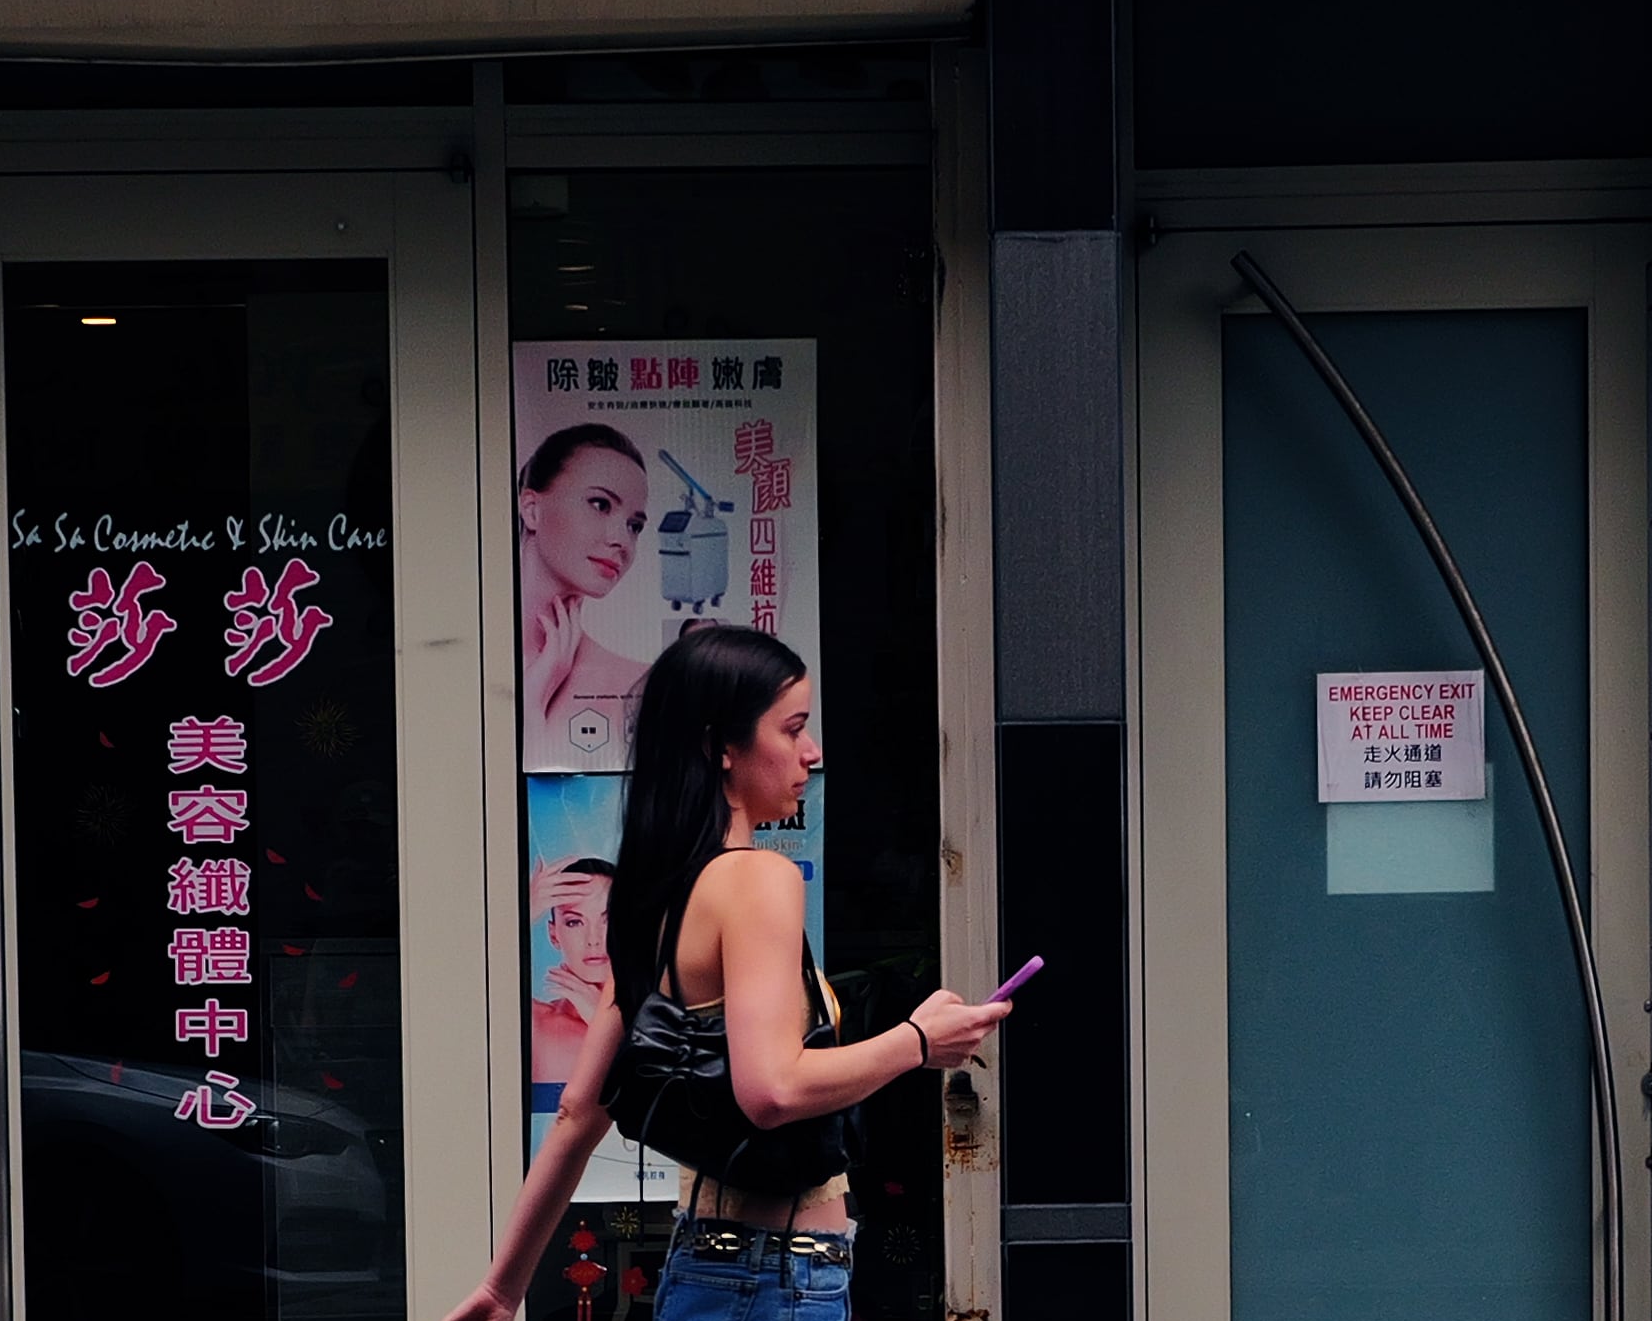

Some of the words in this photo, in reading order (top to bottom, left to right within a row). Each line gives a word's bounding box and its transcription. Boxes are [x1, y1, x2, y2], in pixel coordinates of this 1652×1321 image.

[12, 509, 42, 549] Sa
[54, 513, 85, 552] Sa
[94, 514, 215, 552] Cosmetic
[227, 516, 245, 550] &
[259, 513, 317, 553] Skin
[328, 513, 386, 550] Care
[1329, 684, 1435, 701] EMERGENCY
[1439, 683, 1476, 700] EXIT
[1350, 706, 1394, 722] KEEP
[1398, 705, 1456, 721] CLEAR
[1351, 725, 1373, 741] AT
[1378, 725, 1410, 740] ALL
[1414, 723, 1454, 739] TIME
[1363, 744, 1443, 764] 走火通道
[1364, 770, 1443, 790] 請勿阻塞
[168, 715, 256, 1130] 美容纖體中心
